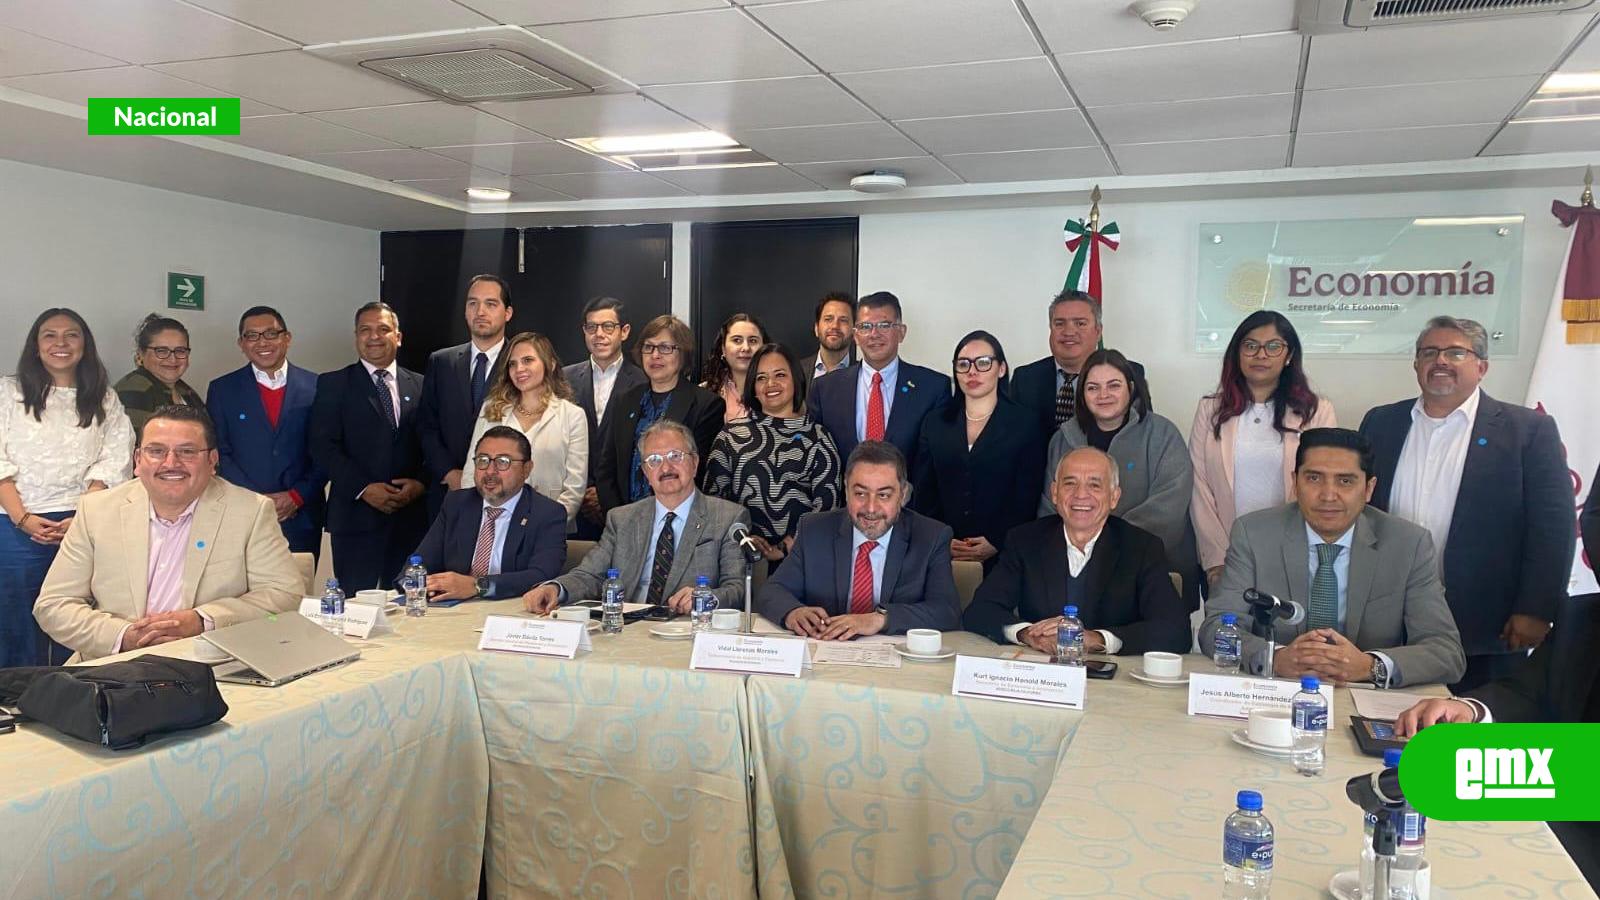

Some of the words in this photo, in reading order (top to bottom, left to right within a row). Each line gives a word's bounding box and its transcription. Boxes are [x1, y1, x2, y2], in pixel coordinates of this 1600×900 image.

[1288, 261, 1494, 297] Economía
[1287, 302, 1336, 312] Secretaría
[1338, 302, 1349, 311] de
[1352, 302, 1399, 311] Economía
[973, 671, 988, 679] Kurt
[1040, 679, 1067, 687] Morales
[1224, 689, 1250, 699] Alberto
